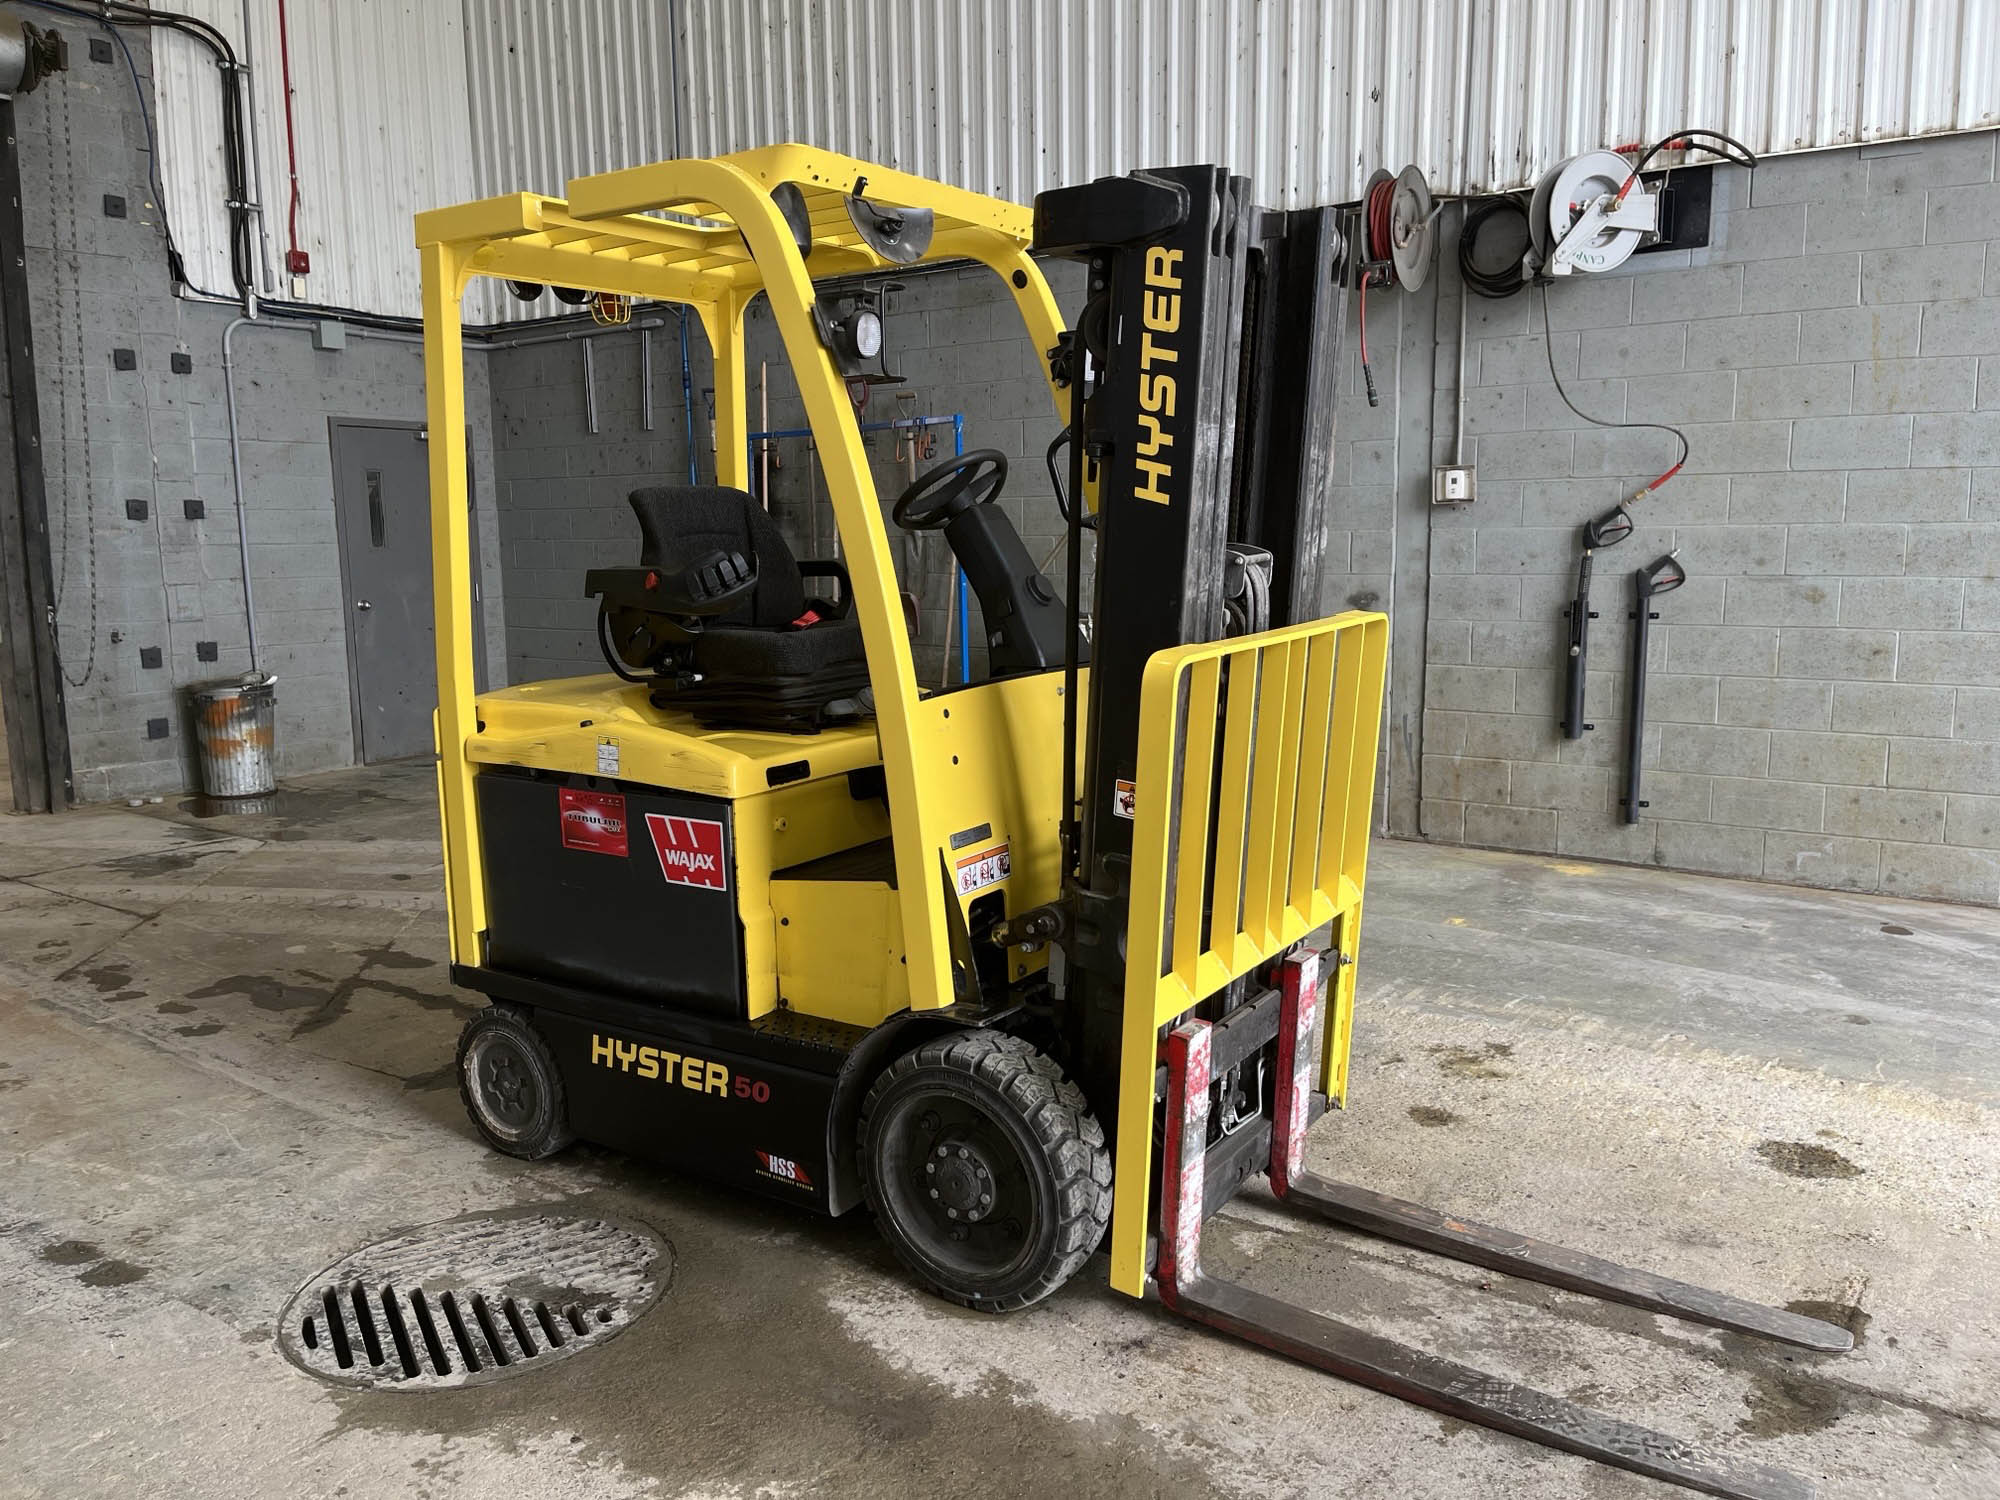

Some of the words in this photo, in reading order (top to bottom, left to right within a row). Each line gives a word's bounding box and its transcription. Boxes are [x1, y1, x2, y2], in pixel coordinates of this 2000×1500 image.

[1134, 246, 1184, 505] HYSTER
[664, 848, 716, 873] WAJAX
[591, 1034, 729, 1098] HYSTER
[734, 1075, 771, 1104] 50
[768, 1154, 796, 1179] HSS
